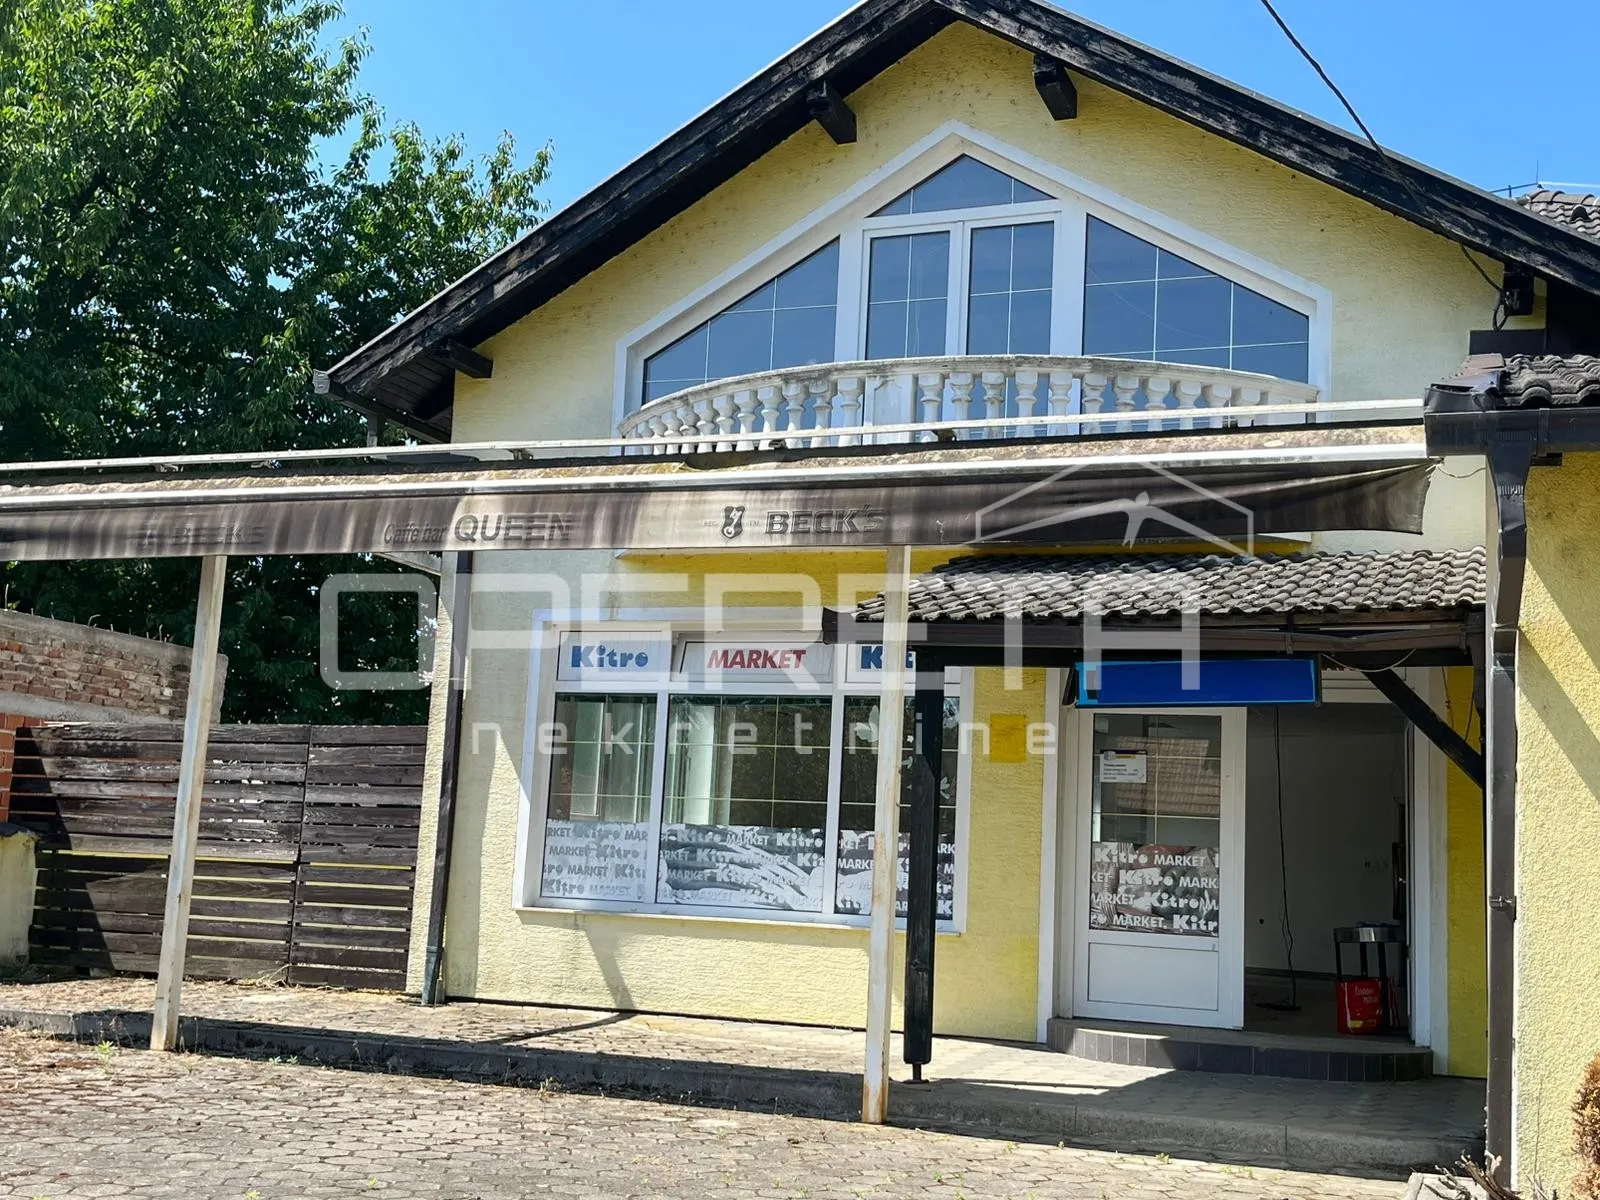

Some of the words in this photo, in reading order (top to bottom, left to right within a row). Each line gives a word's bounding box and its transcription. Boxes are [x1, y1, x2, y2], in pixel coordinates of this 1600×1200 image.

[423, 523, 446, 544] bar
[454, 514, 571, 543] QUEEN
[571, 645, 649, 667] Kitro
[707, 649, 807, 669] MARKET
[776, 832, 823, 848] Kitro
[1095, 846, 1148, 864] Kitro
[1154, 854, 1206, 867] MARKET
[1143, 891, 1199, 909] Kitro
